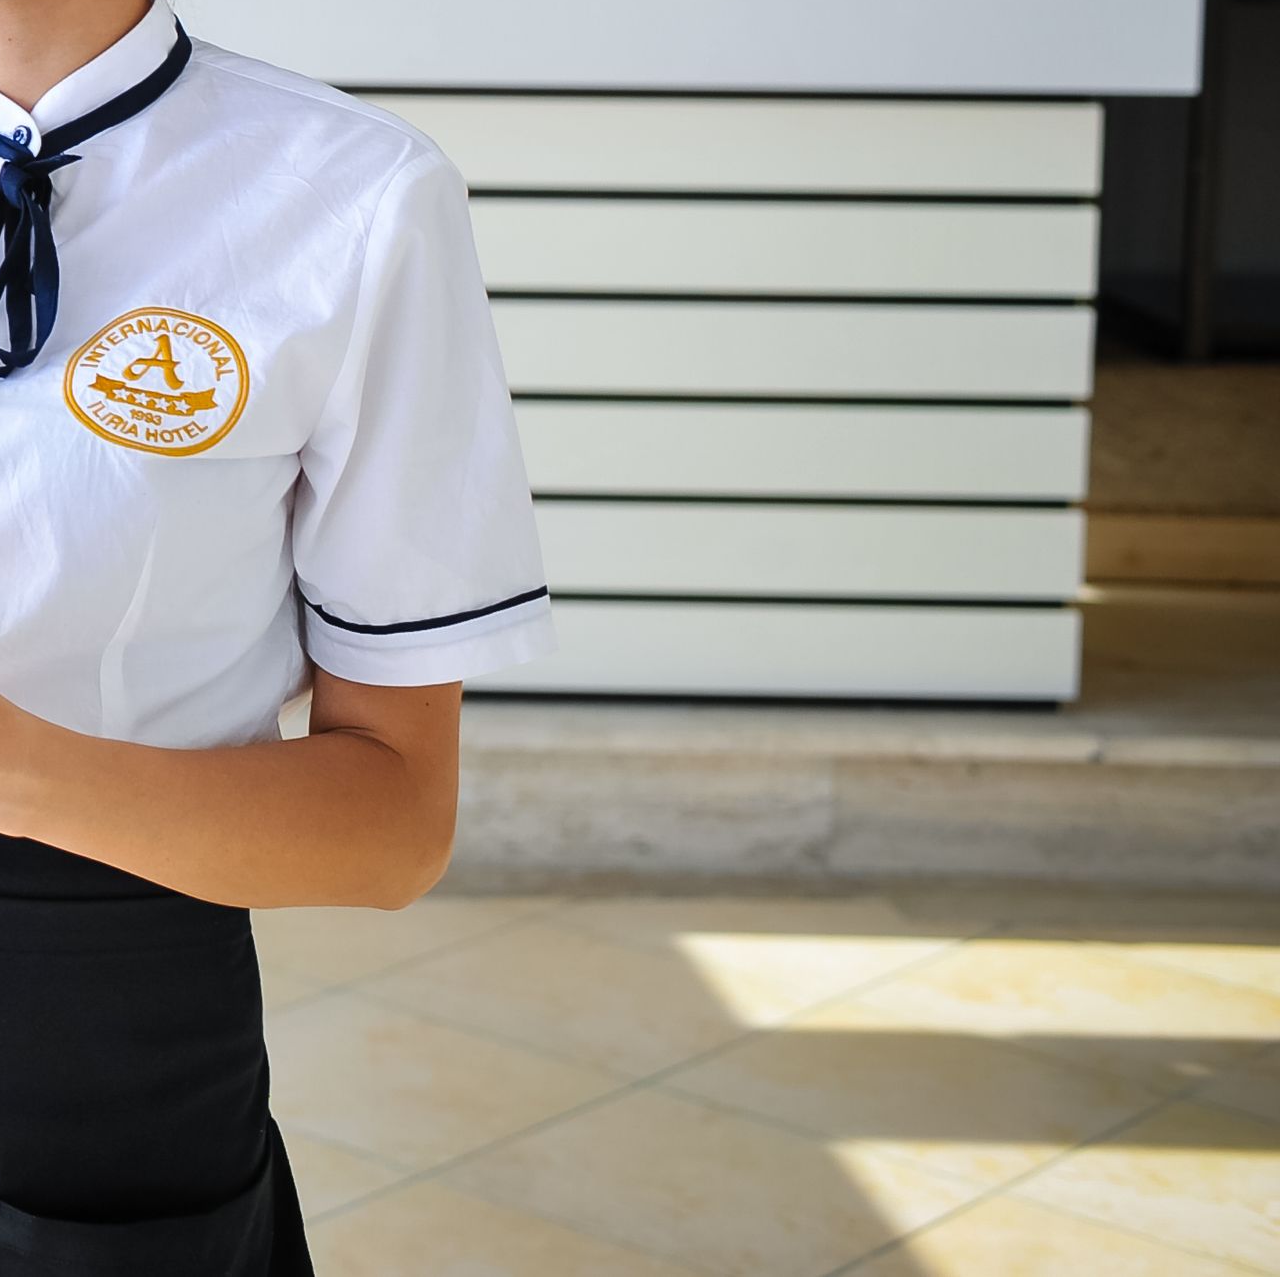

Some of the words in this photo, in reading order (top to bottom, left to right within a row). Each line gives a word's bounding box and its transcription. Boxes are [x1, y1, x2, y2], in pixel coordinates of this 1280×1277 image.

[80, 318, 235, 382] INTERNACIONAL
[87, 400, 139, 438] ILIRIA
[145, 421, 209, 444] HOTEL
[129, 409, 163, 426] 1993
